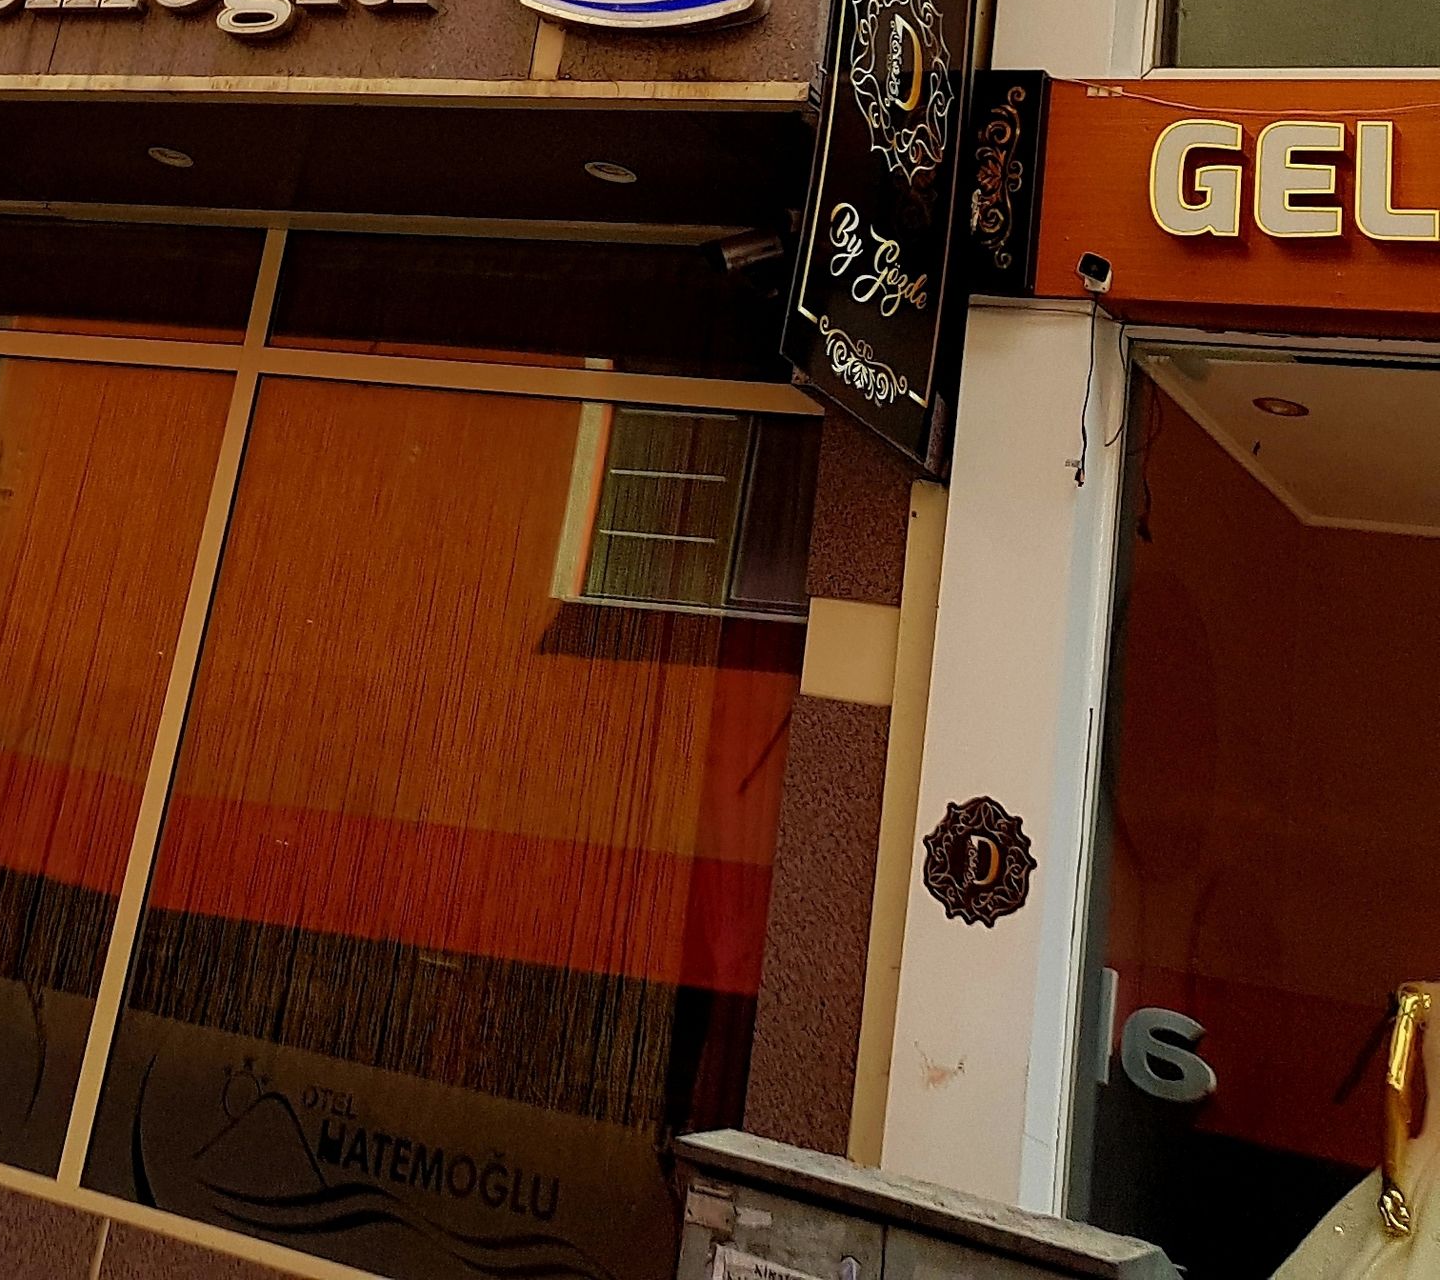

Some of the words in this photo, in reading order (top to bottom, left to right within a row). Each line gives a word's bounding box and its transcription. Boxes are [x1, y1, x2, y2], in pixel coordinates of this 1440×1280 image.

[1149, 118, 1440, 241] GEL
[829, 202, 863, 276] By
[851, 224, 927, 316] Gözde
